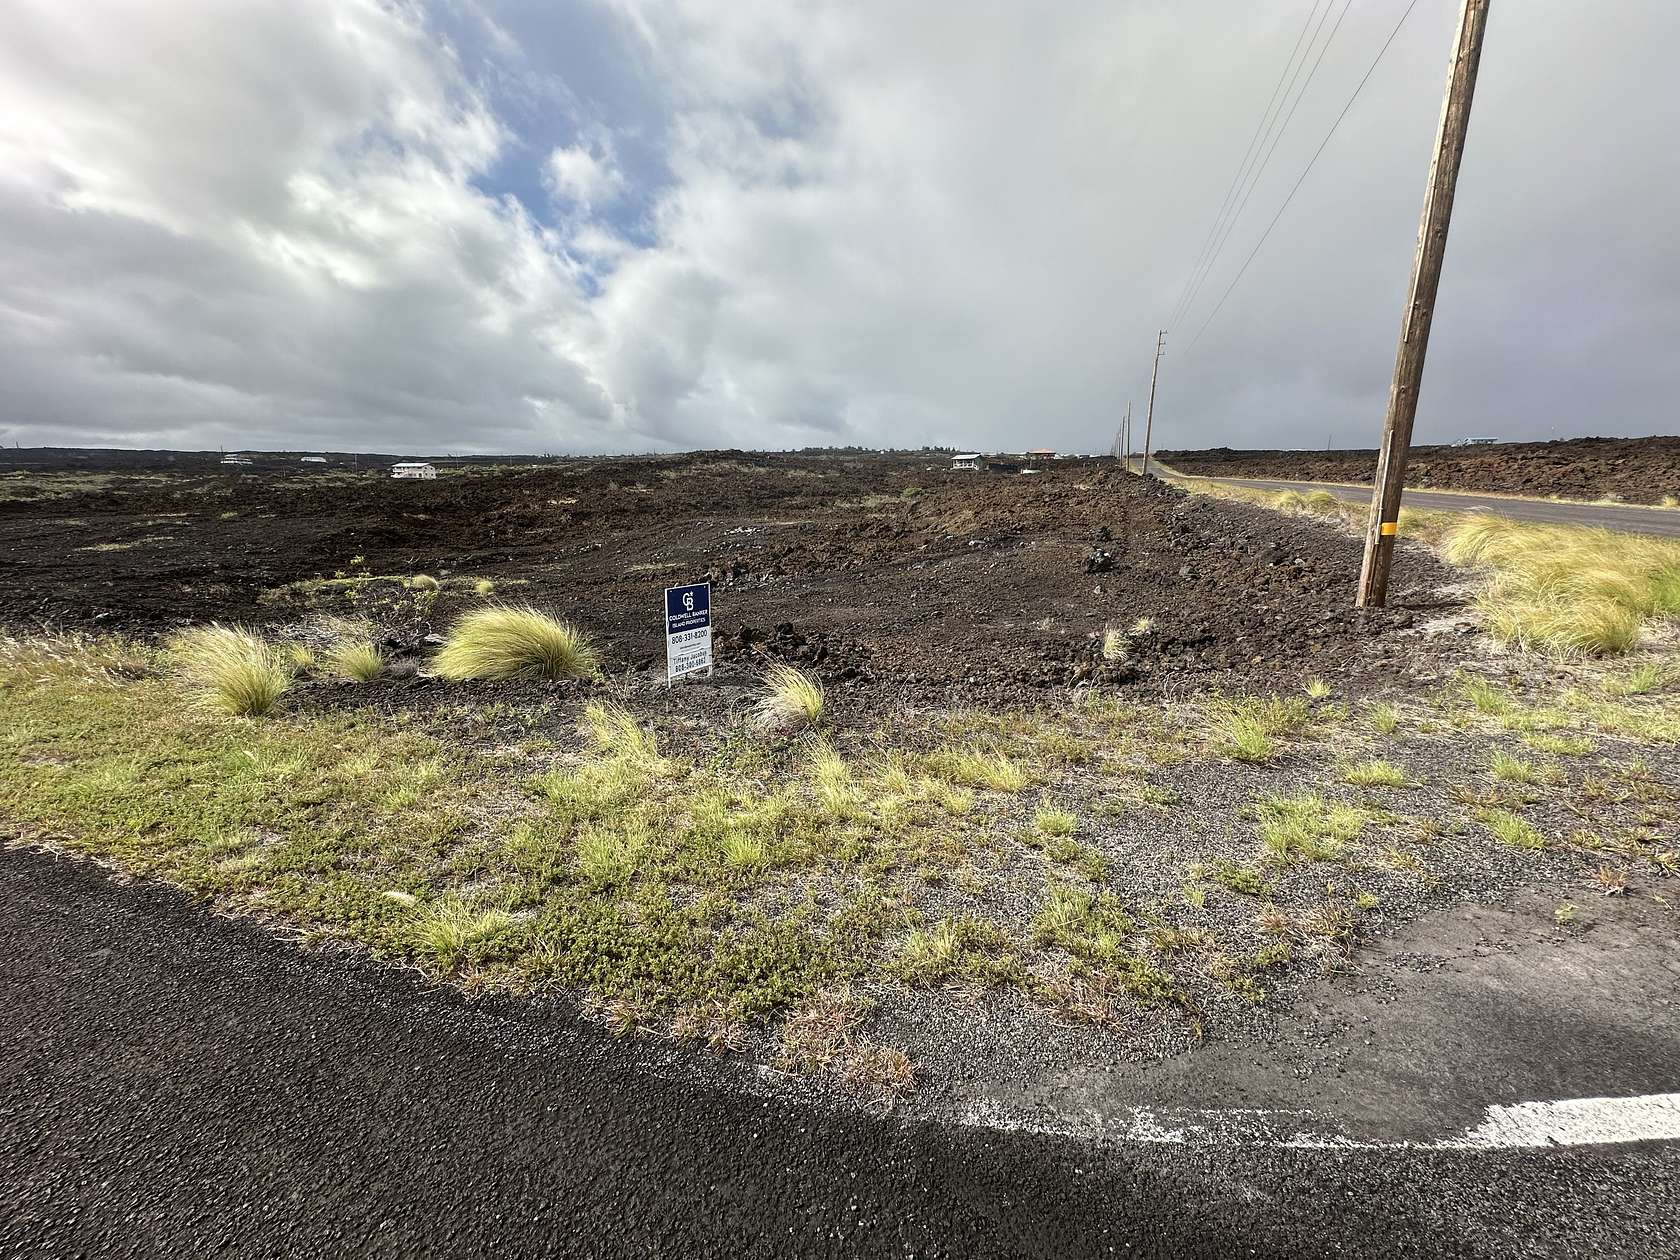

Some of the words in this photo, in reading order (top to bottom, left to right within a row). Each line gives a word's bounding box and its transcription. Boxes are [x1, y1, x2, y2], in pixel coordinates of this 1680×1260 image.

[669, 612, 692, 622] COLDWELL
[692, 609, 708, 617] BANKER
[672, 621, 685, 629] ISLAND
[686, 618, 706, 626] PROPERTIES
[671, 629, 708, 645] 808-331-8200
